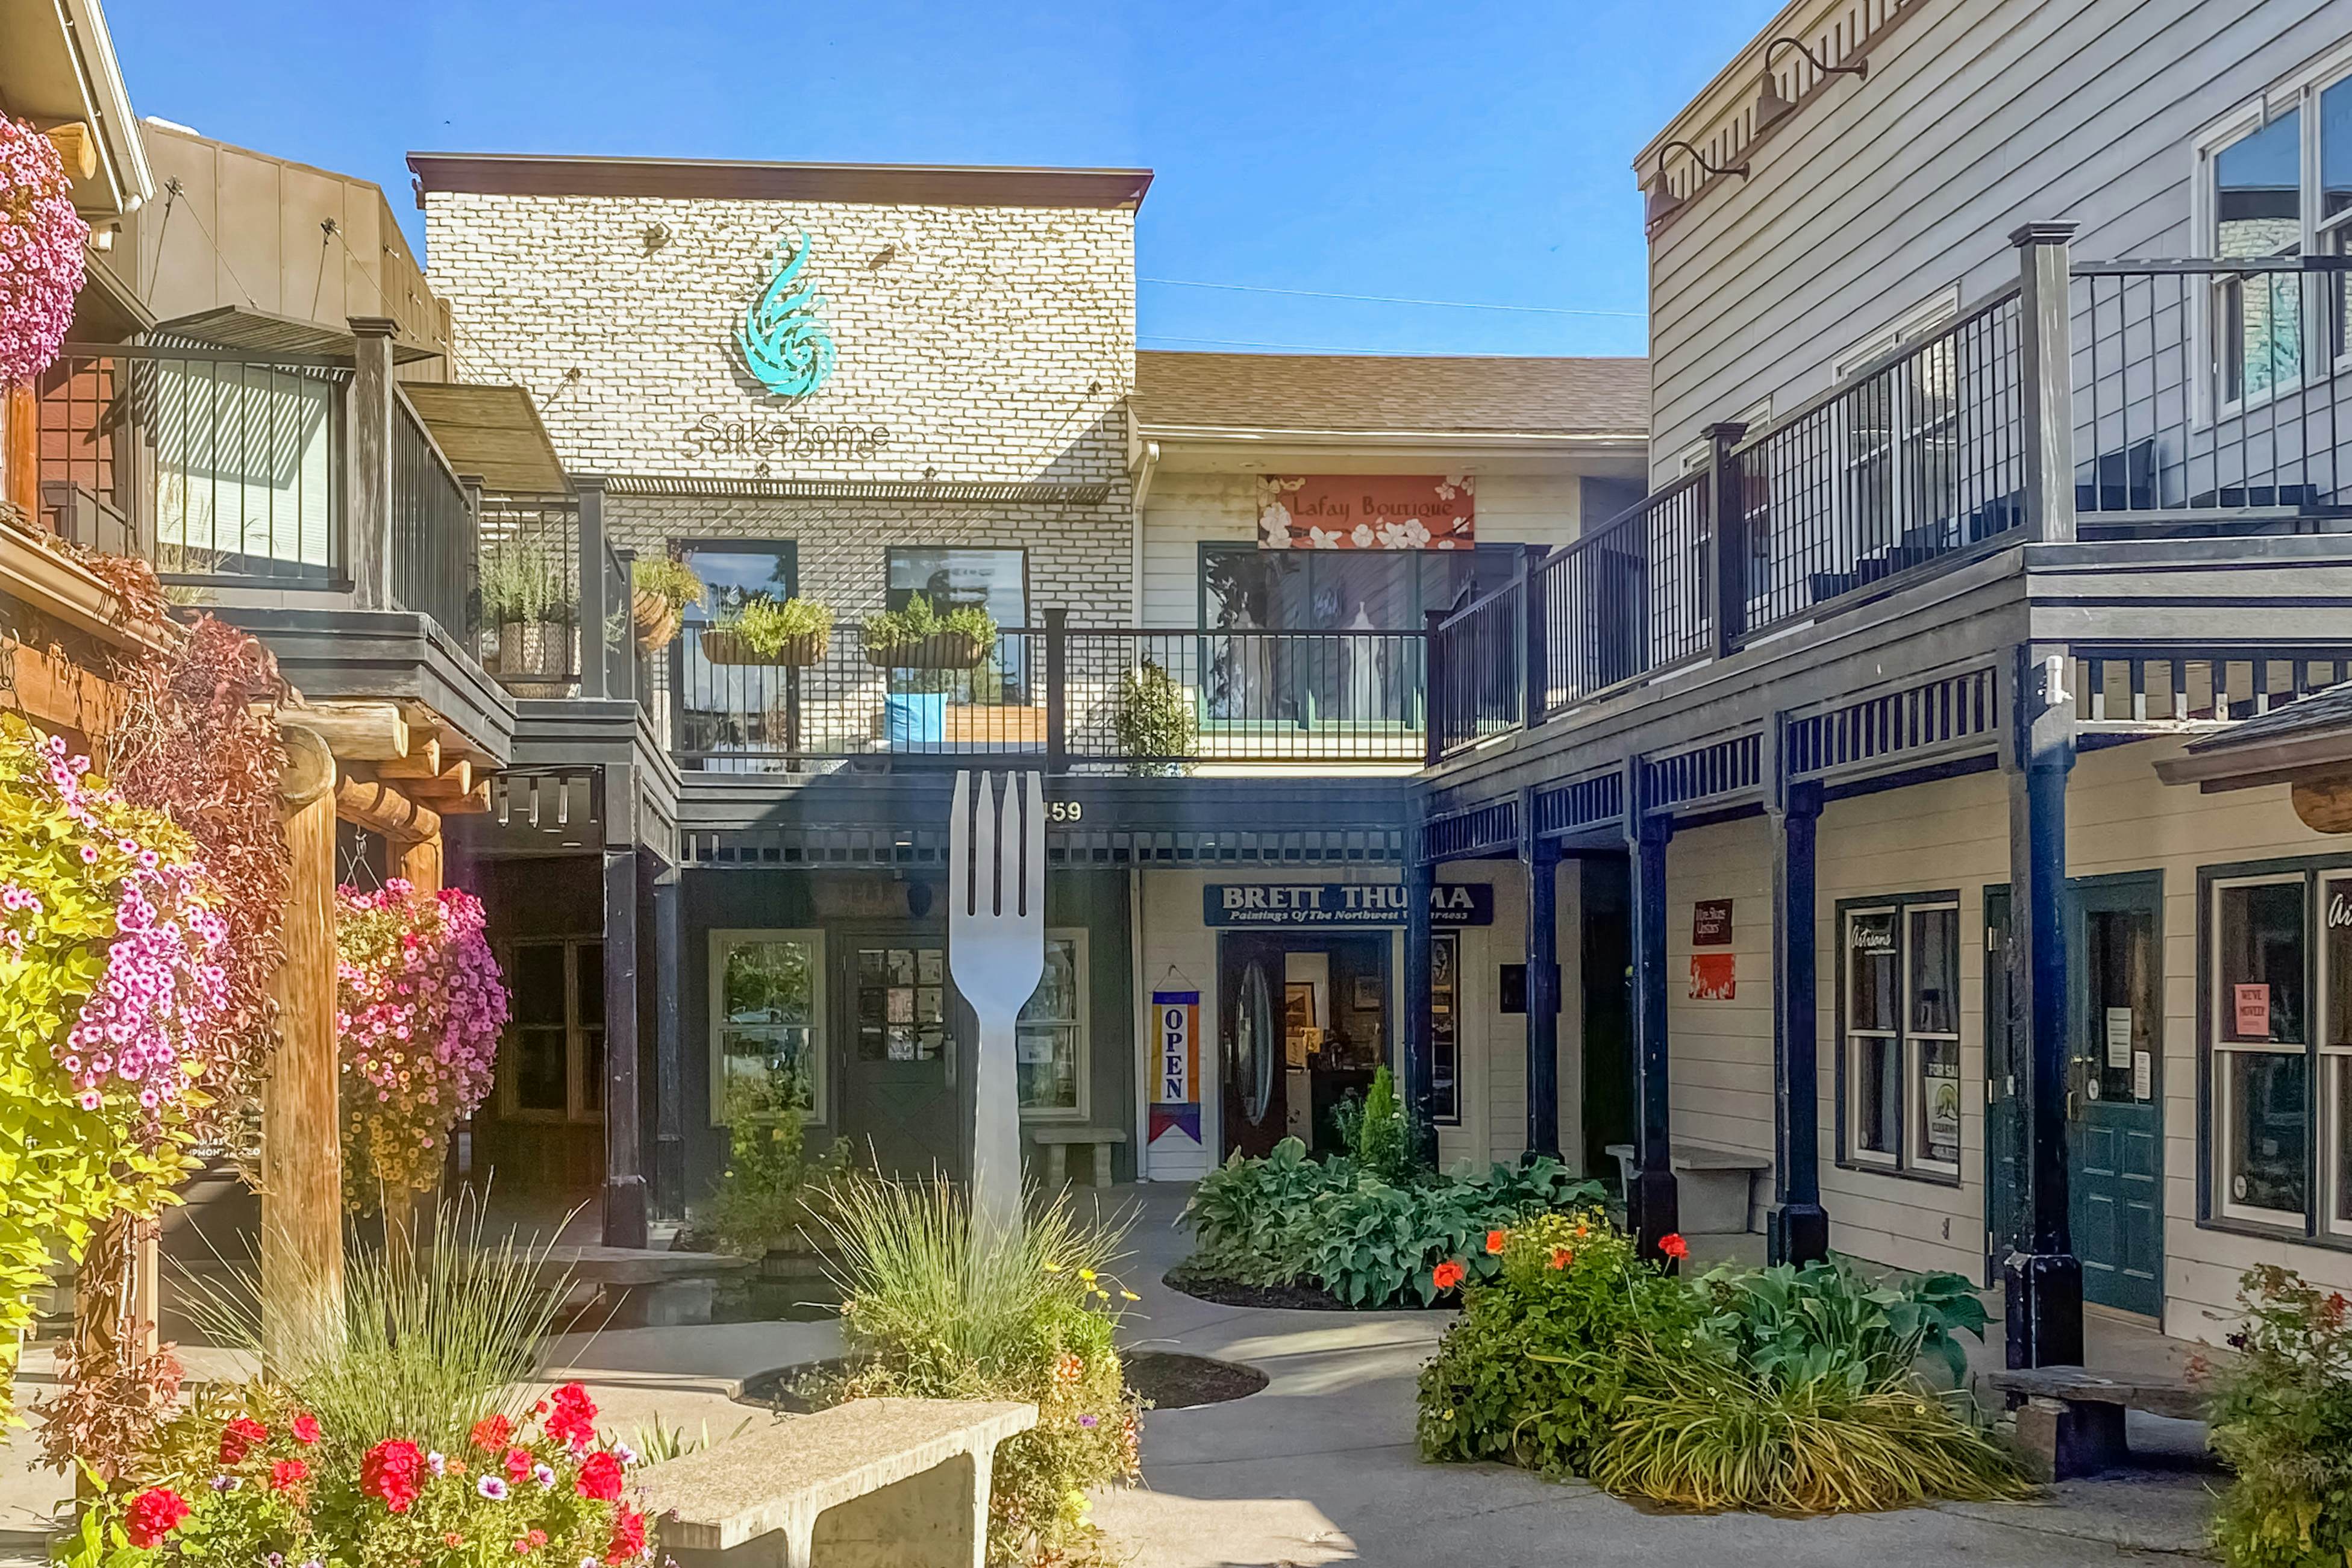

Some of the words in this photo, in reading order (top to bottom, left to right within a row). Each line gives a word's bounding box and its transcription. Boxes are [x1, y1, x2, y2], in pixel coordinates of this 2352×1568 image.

[1362, 496, 1453, 517] Boutique
[1223, 887, 1324, 908] BRETT
[1230, 911, 1288, 922] Paintings
[1292, 911, 1309, 922] Of
[1309, 911, 1332, 920] The
[1334, 910, 1398, 920] Northwest
[1165, 1009, 1183, 1099] OPEN
[1928, 1063, 1944, 1076] FOR
